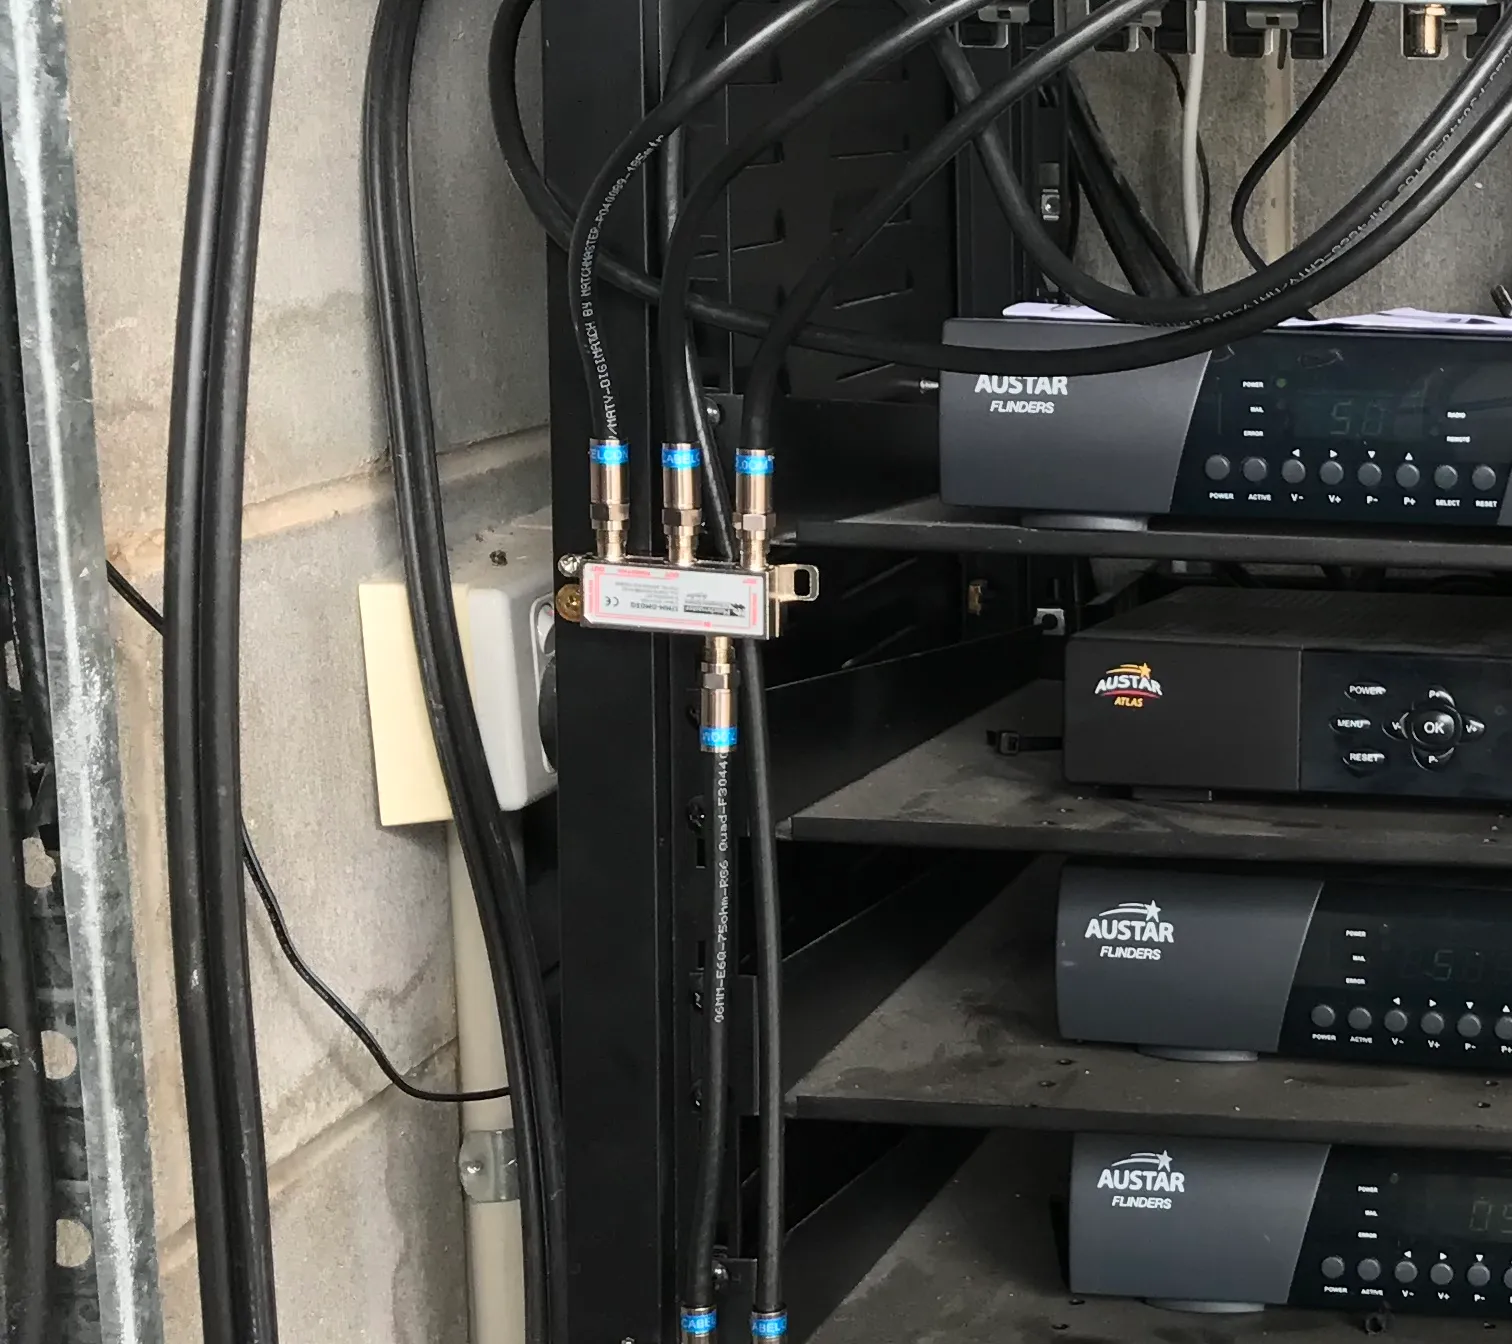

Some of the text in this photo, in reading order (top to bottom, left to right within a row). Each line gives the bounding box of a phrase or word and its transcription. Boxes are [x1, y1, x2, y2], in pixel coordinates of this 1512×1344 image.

[975, 374, 1068, 396] AUSTAR
[990, 400, 1054, 414] FLINDERS
[1209, 492, 1234, 500] POWER
[1248, 493, 1271, 502] ACTIVE
[1328, 494, 1341, 504] V+
[1404, 496, 1416, 506] P+
[1435, 499, 1460, 507] SELECT
[1475, 500, 1497, 508] RESET
[1095, 674, 1163, 696] AUSTAR
[1349, 686, 1383, 696] POWER
[1114, 696, 1143, 708] ATLAS
[1337, 718, 1364, 728] MENU
[1424, 721, 1444, 734] OK
[1349, 752, 1379, 762] RESET
[1085, 918, 1174, 943] AUSTAR
[1100, 946, 1162, 960] FLINDERS
[1097, 1169, 1185, 1192] AUSTAR
[1112, 1195, 1172, 1210] FLINDERS
[1323, 1286, 1348, 1294] POWER
